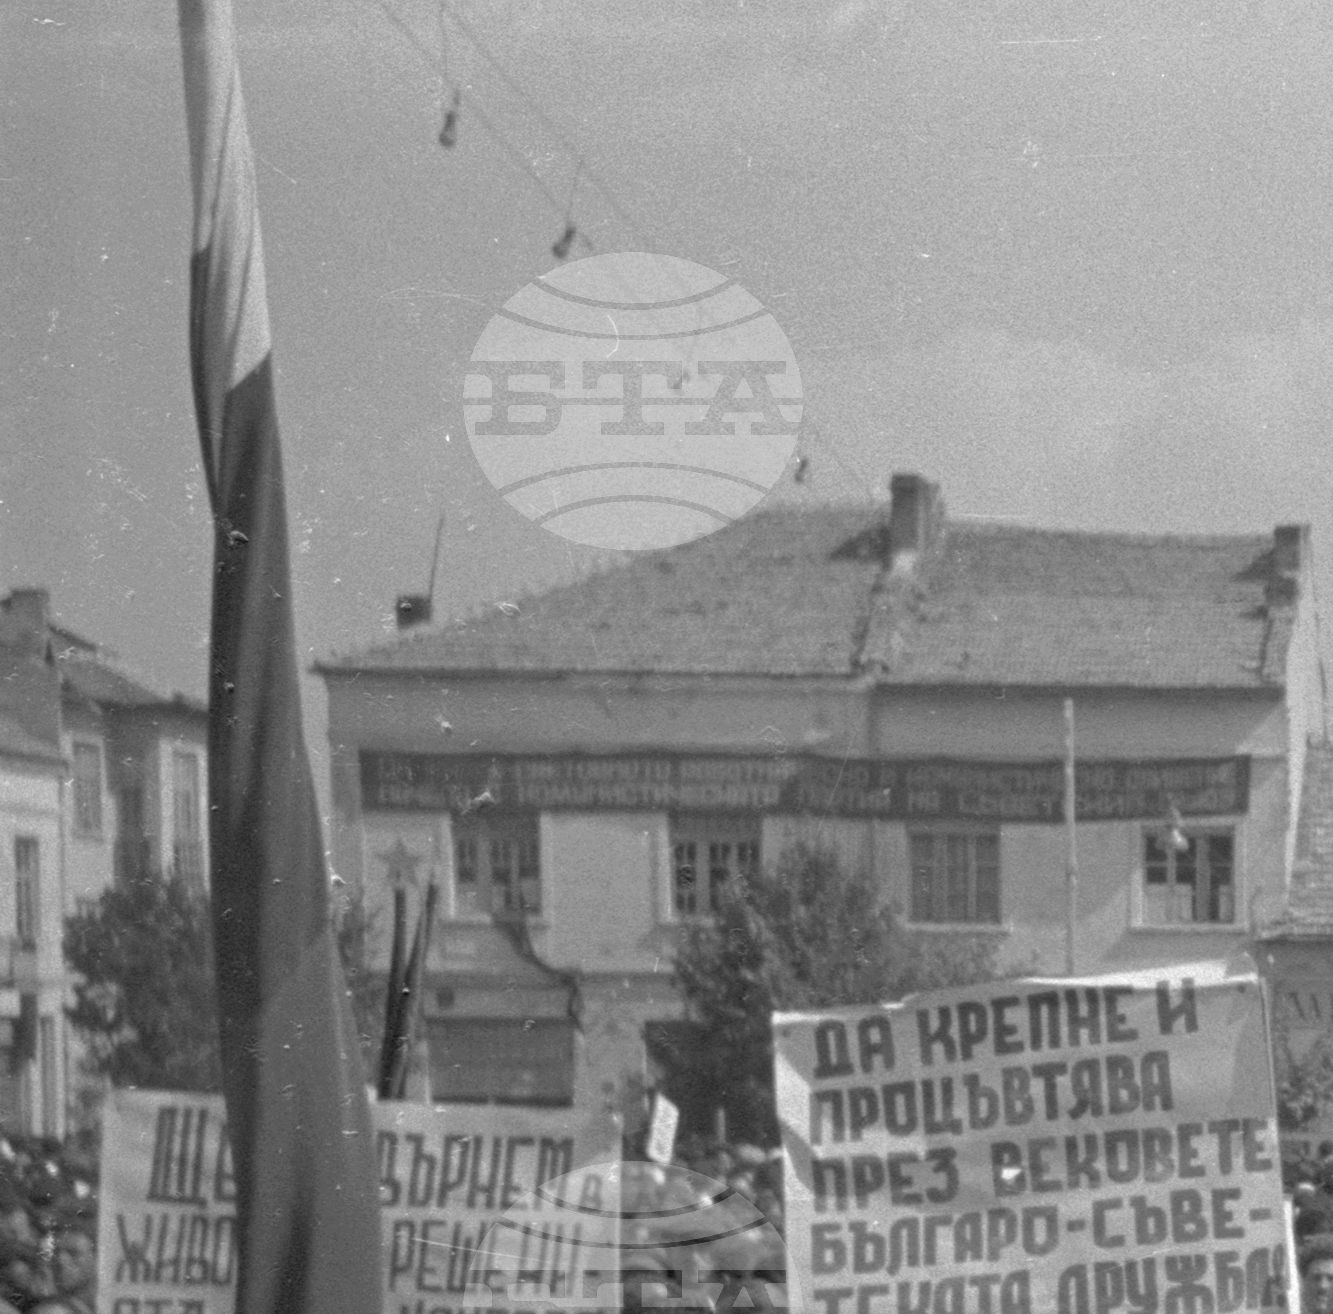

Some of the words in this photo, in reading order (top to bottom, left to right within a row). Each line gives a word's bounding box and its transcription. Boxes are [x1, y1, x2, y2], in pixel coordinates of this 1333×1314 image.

[815, 1013, 895, 1079] ДА
[917, 985, 1139, 1066] КРЕПНЕ
[1156, 977, 1198, 1036] И
[809, 1050, 1174, 1146] ПРОЦЪВТЯВА
[811, 1147, 960, 1214] ПРЕЗ
[992, 1117, 1274, 1199] ВЕКОВЕТЕ
[113, 1212, 239, 1286] ЖИВО
[811, 1188, 1272, 1277] БЪЛГАРО-СЪВЕ-
